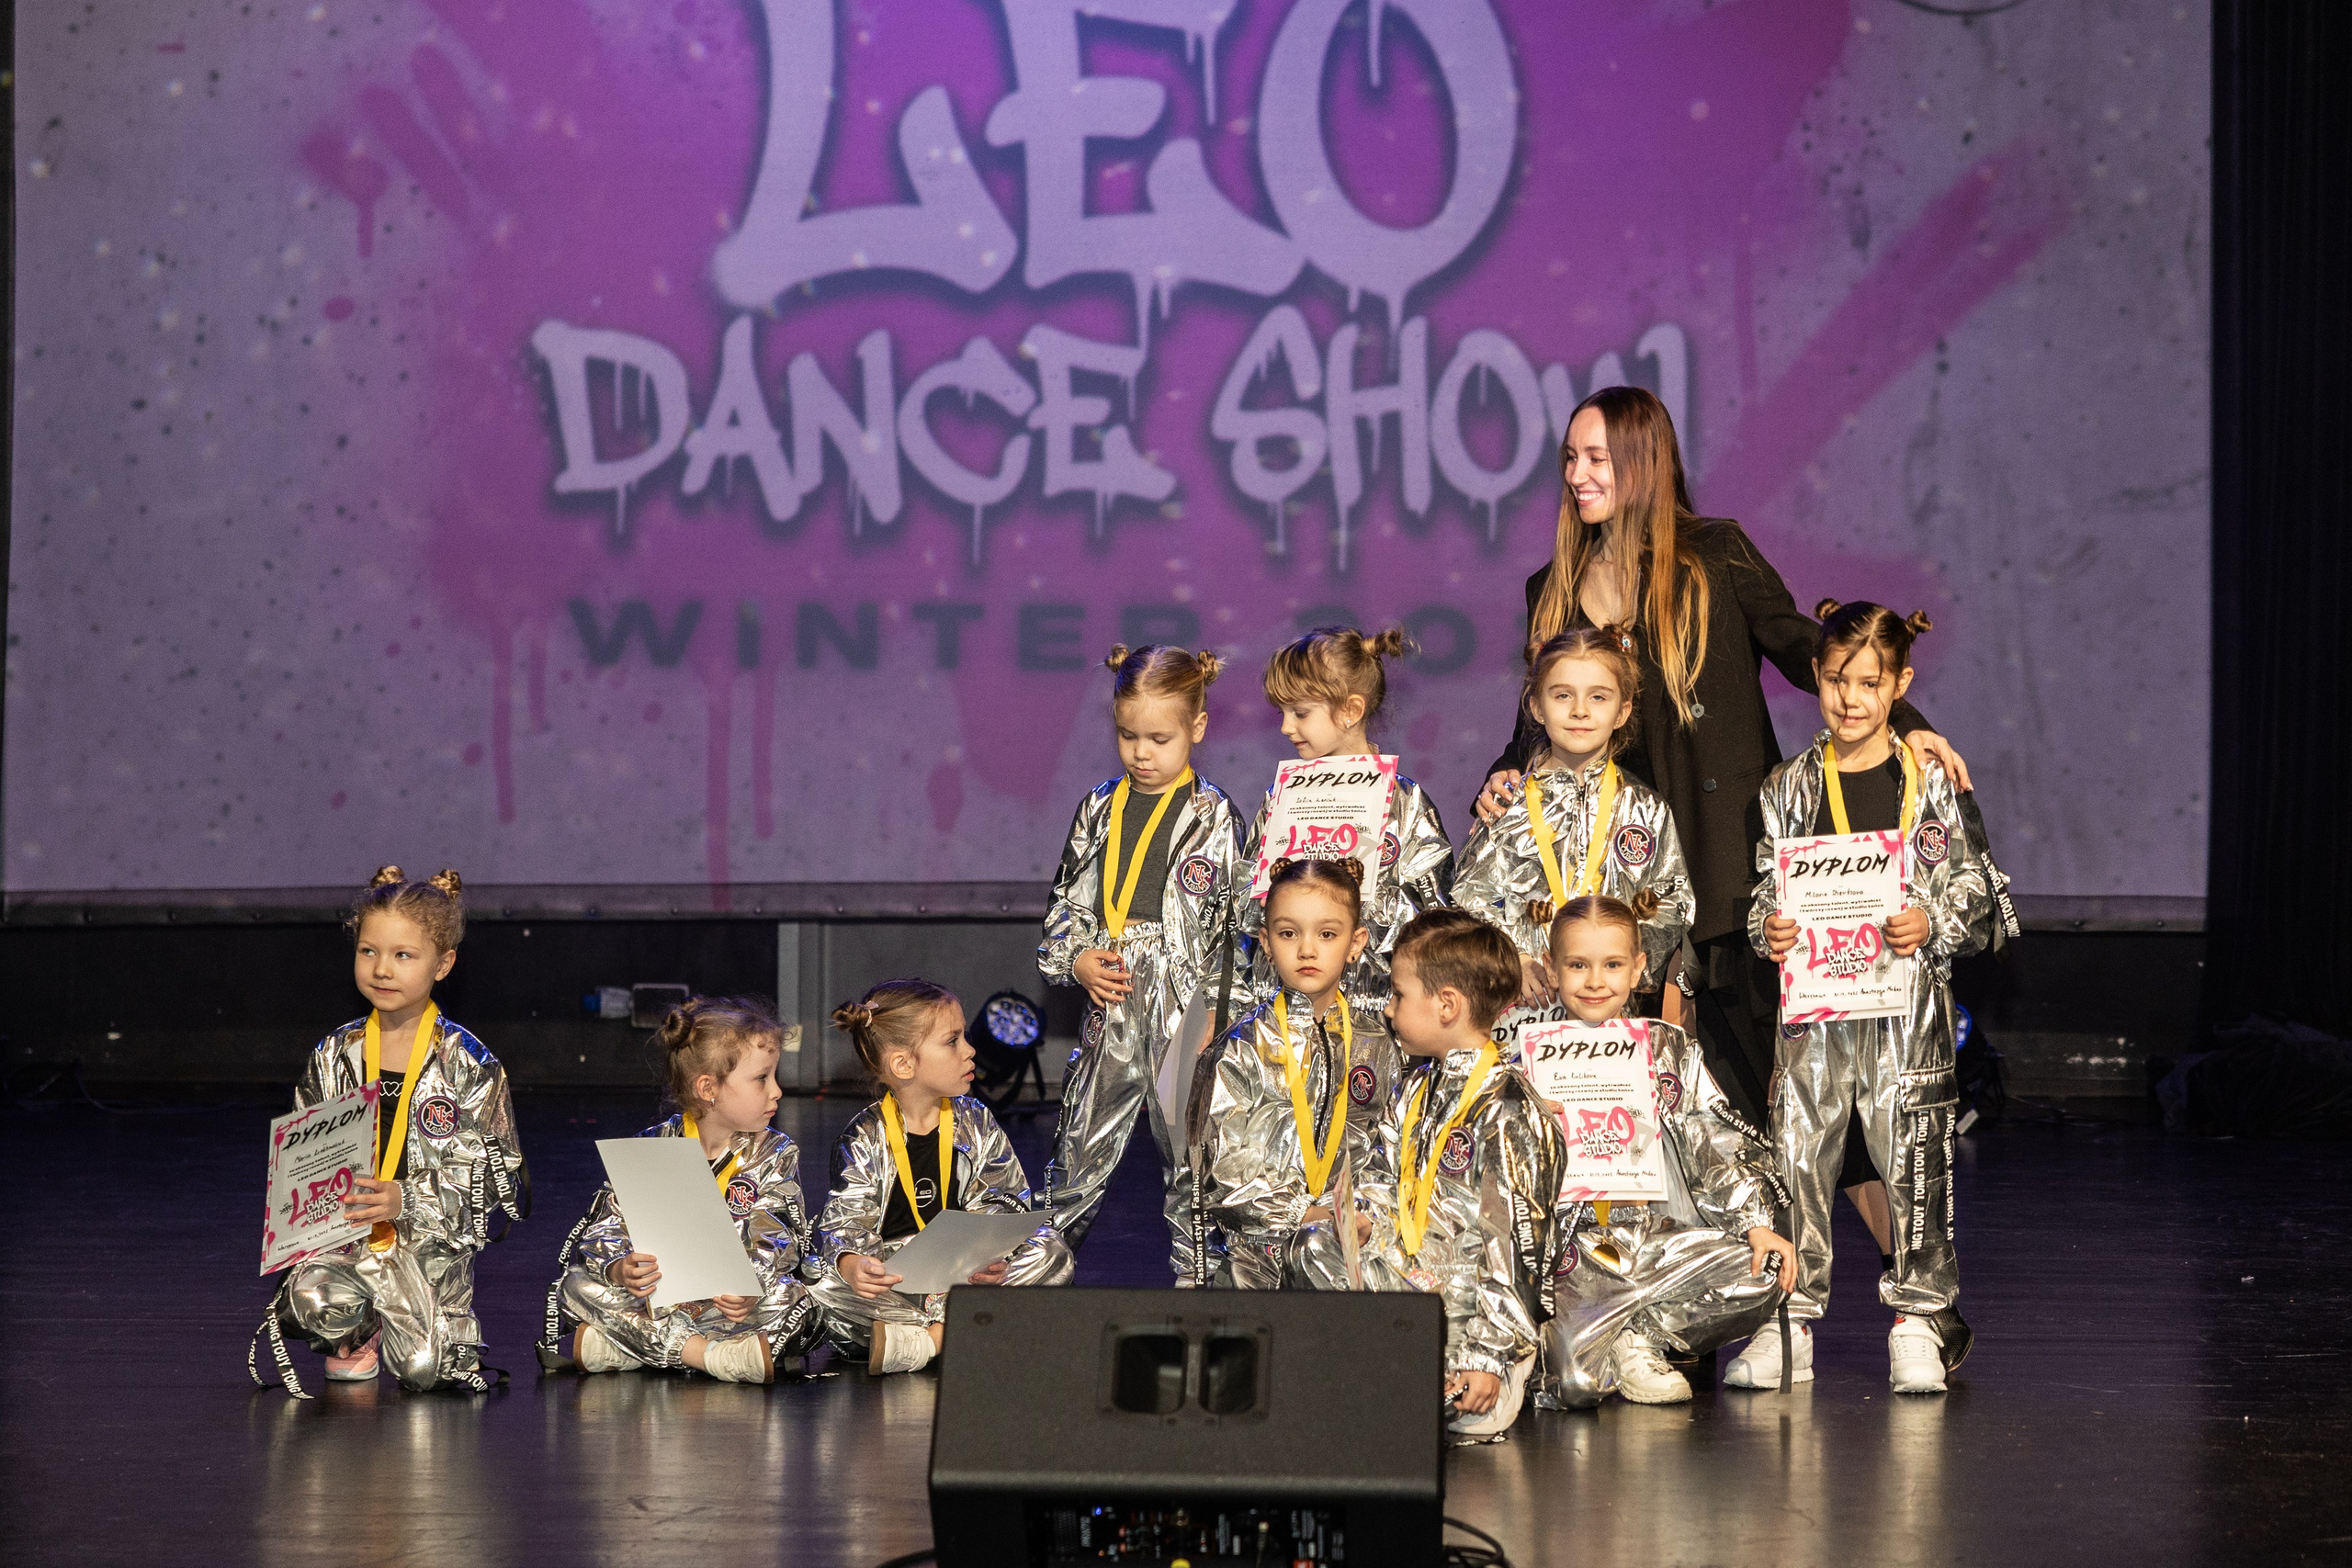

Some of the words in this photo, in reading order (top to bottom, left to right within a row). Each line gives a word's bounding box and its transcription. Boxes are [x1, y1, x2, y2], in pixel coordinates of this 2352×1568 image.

[710, 0, 1521, 320] LEO
[535, 313, 1176, 537] DANCE
[1284, 772, 1382, 789] DYPLOM
[1303, 841, 1340, 853] DANCE
[1788, 854, 1890, 879] DYPLOM
[1826, 947, 1866, 964] DANCE
[1829, 959, 1867, 977] STUDIO
[1536, 1040, 1637, 1062] DYPLOM
[281, 1102, 368, 1152] DYPLOM
[1711, 1101, 1735, 1122] shion
[1733, 1119, 1758, 1137] style
[1579, 1130, 1620, 1145] DANCE
[1584, 1142, 1623, 1157] STUDIO
[306, 1190, 338, 1213] DANCE
[1192, 1170, 1200, 1209] Fashio
[308, 1200, 340, 1224] STUDIO
[1193, 1214, 1204, 1242] style
[1196, 1244, 1204, 1285] Fashion
